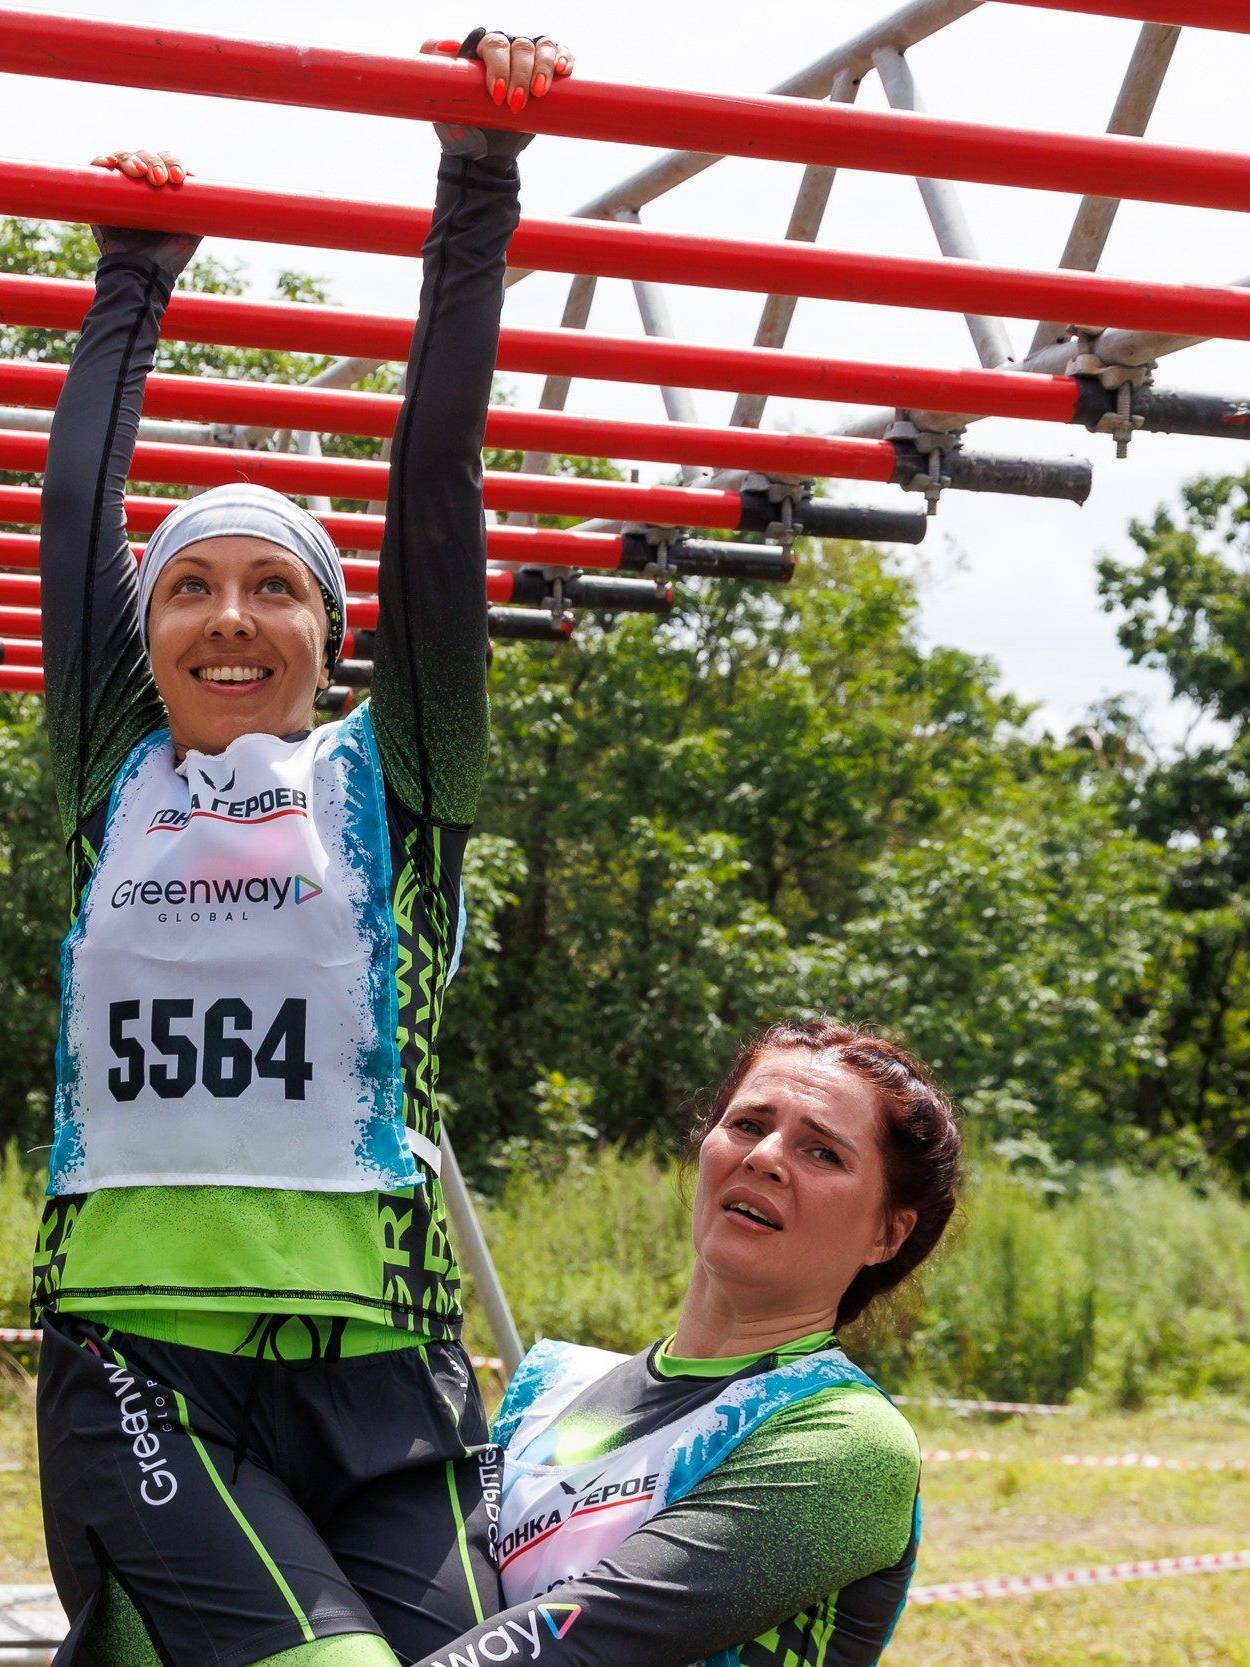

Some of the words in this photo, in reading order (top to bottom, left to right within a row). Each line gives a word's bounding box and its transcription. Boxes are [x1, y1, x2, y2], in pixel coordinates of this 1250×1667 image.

[149, 793, 202, 828] ГОНА
[210, 787, 307, 819] ГЕРОЕВ
[111, 876, 292, 911] Greenway
[158, 911, 249, 923] GLOBAL
[107, 998, 313, 1102] 5564
[103, 1363, 178, 1506] Greenw
[570, 1472, 660, 1514] ГЕРОЕ
